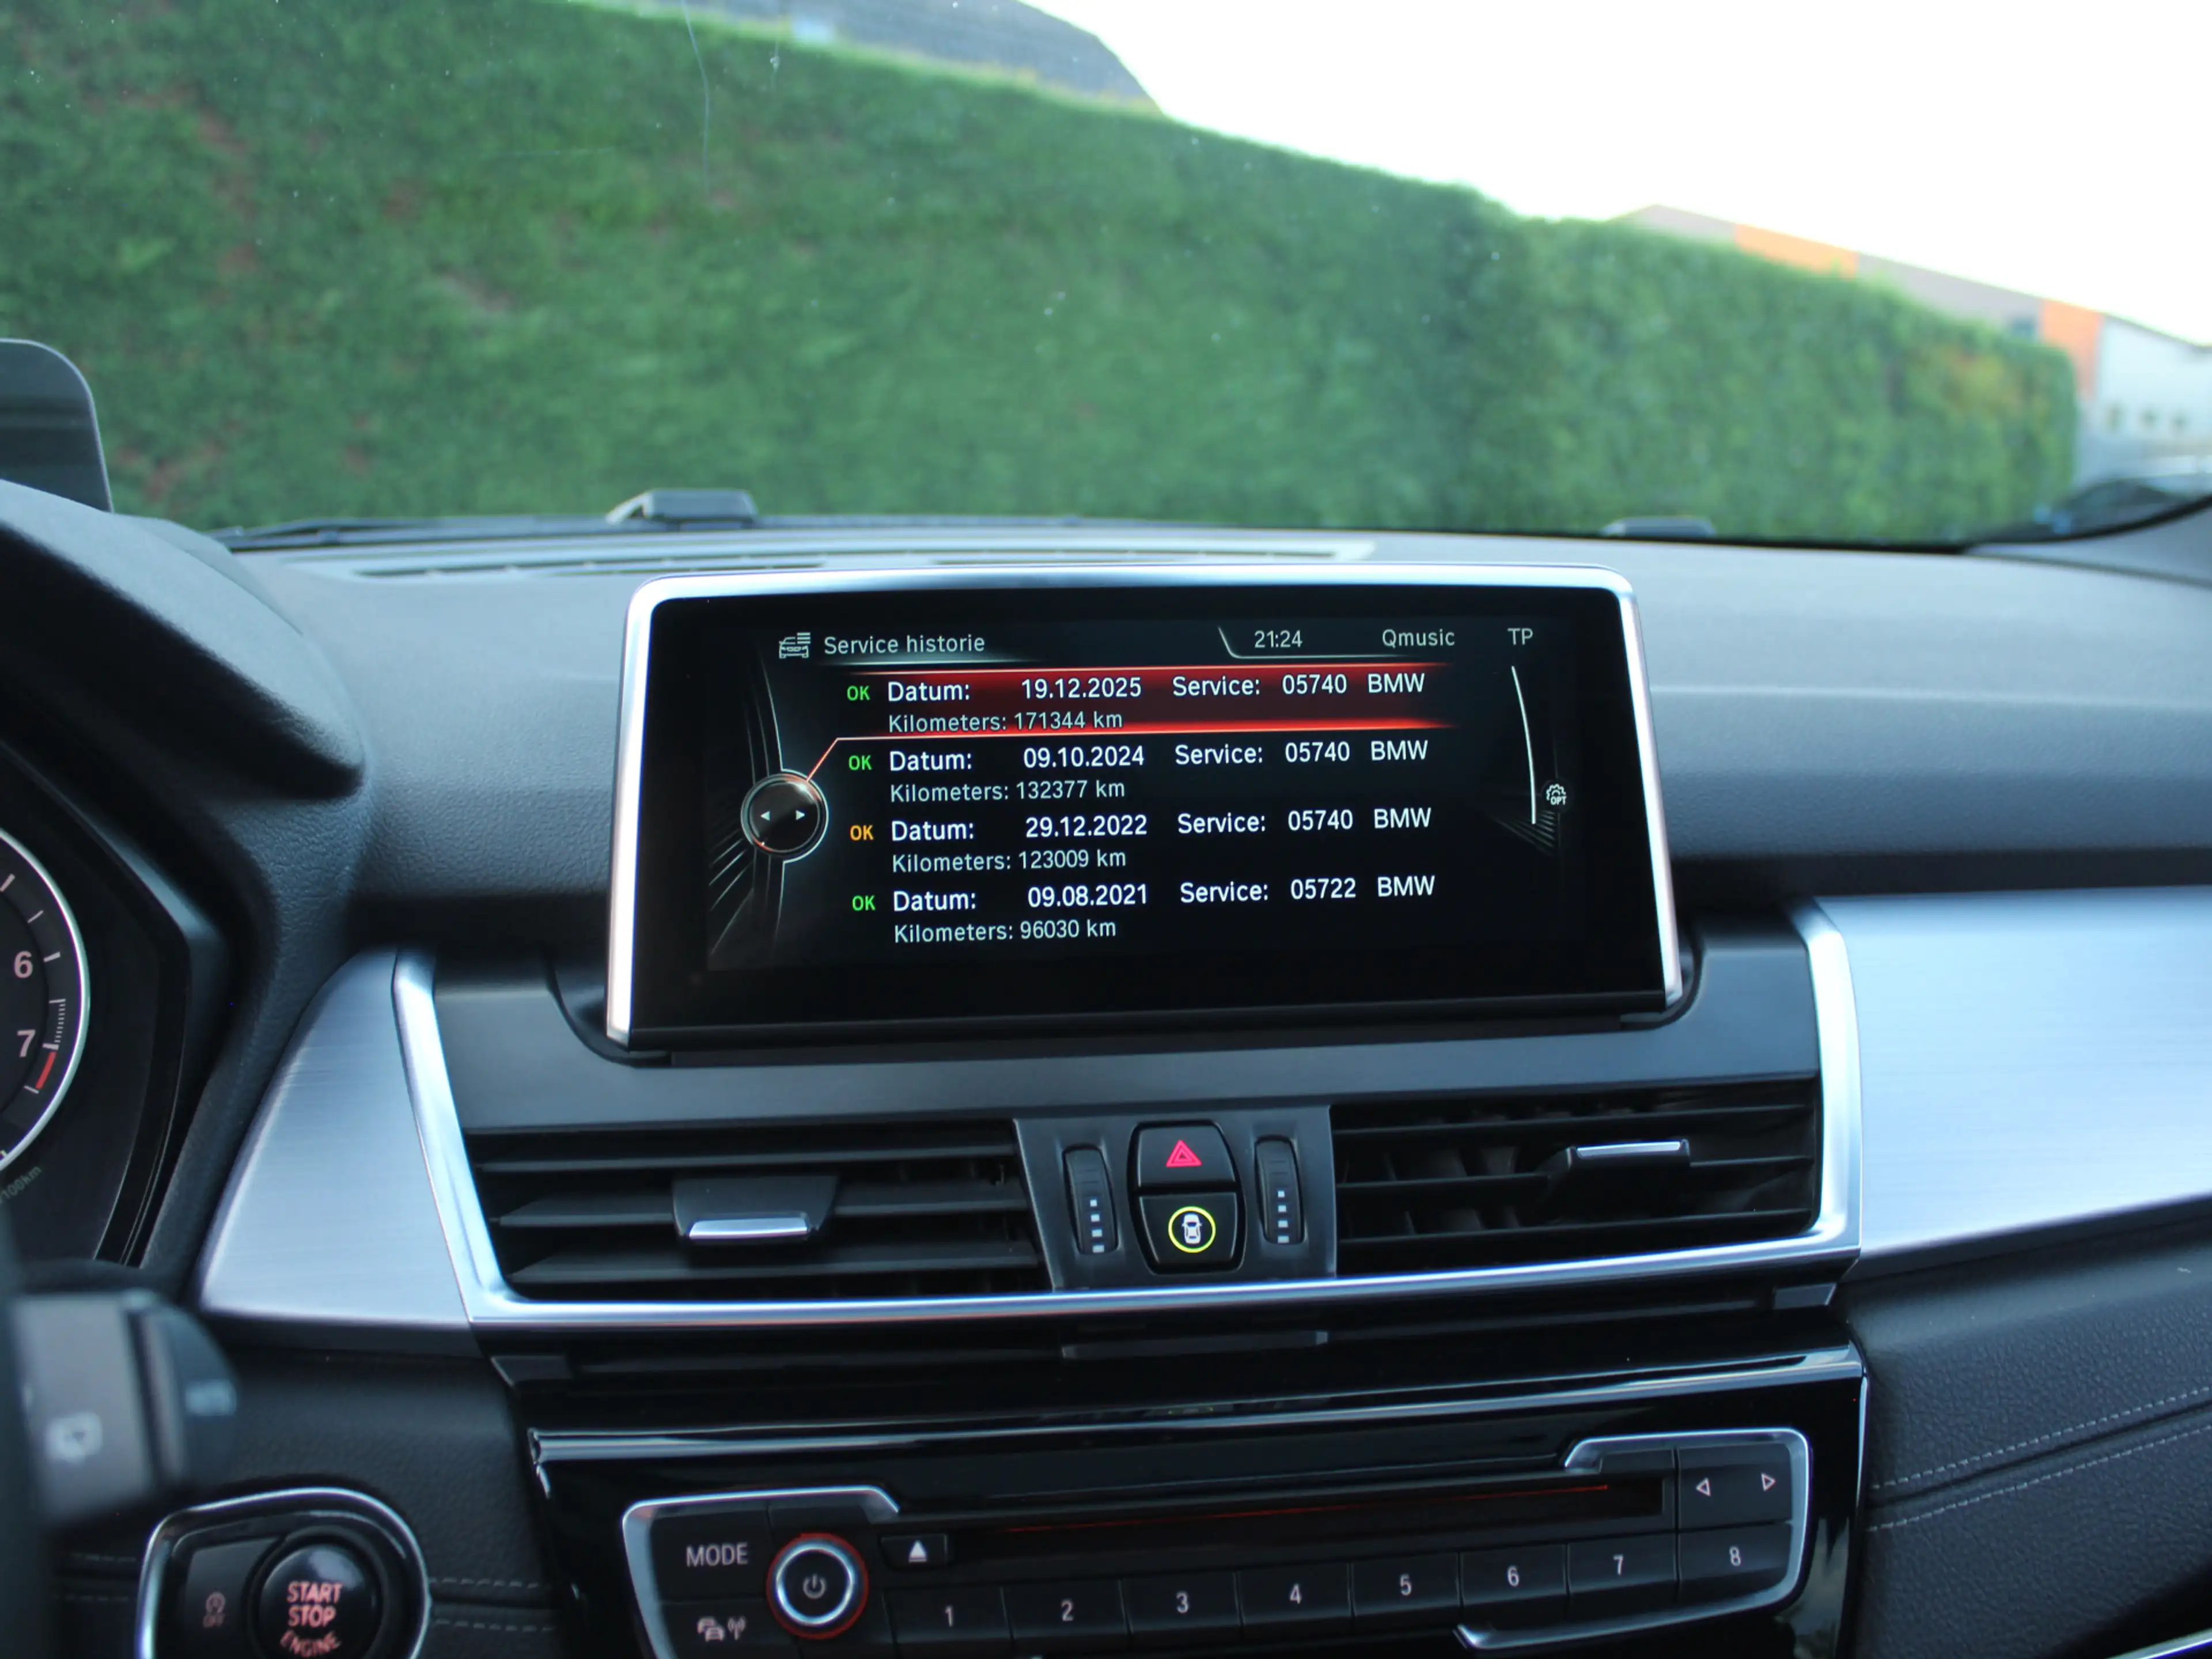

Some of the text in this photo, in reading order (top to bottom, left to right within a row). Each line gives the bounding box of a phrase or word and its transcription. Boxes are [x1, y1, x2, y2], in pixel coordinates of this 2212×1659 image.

[824, 634, 985, 654] Service historie
[1255, 630, 1302, 648] 21:24
[1382, 628, 1455, 649] Qmusic
[1507, 628, 1533, 645] TP
[847, 673, 1425, 702] OK Datum: 19.12.2025 Service: 05740 BMW
[889, 711, 1122, 732] Kilometers: 171344 km
[849, 740, 1428, 771] OK Datum: 09.10.2024 Service: 05740 BMW
[891, 779, 1124, 802] Kilometers: 132377 km
[1551, 796, 1567, 805] OPT
[850, 807, 1431, 842] OK Datum: 29.12.2022 Service: 05740 BMW
[893, 849, 1126, 873] Kilometers: 123009 km
[852, 875, 1435, 912] OK Datum: 09.08.2021 Service: 05722 BMW
[895, 919, 1116, 943] Kilometers: 96030 km
[14, 950, 33, 978] 6
[17, 1029, 36, 1058] 7
[686, 1543, 747, 1567] MODE
[1613, 1555, 1623, 1575] 7
[1729, 1547, 1741, 1566] 8
[1400, 1574, 1412, 1596] 5
[1507, 1566, 1520, 1586] 6
[287, 1581, 342, 1604] START
[1176, 1592, 1189, 1613] 3
[1290, 1584, 1302, 1604] 4
[288, 1604, 336, 1627] STOP
[945, 1605, 953, 1627] 1
[1062, 1600, 1073, 1622] 2
